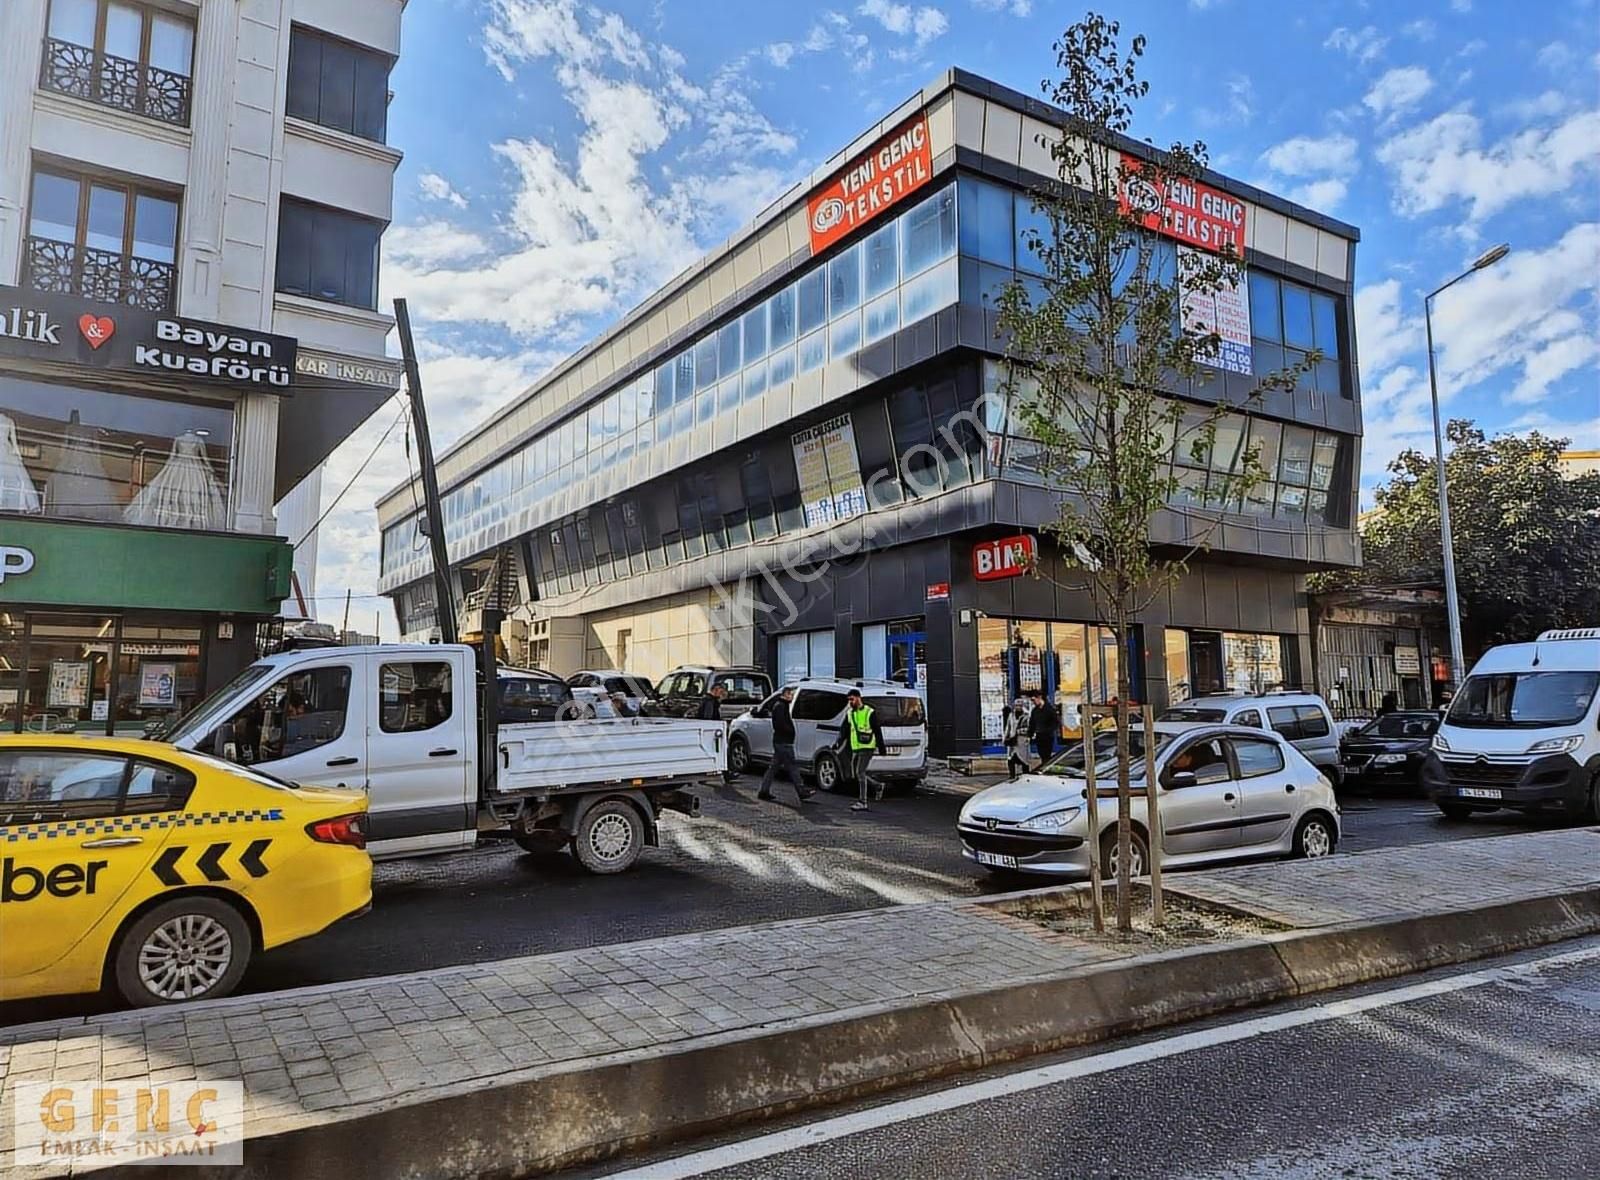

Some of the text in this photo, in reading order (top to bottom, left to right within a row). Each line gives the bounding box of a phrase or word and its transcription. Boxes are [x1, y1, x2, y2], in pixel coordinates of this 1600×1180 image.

[878, 122, 925, 172] GENÇ
[1201, 192, 1242, 229] GENÇ
[156, 320, 272, 358] Bayan
[135, 345, 290, 386] Kuaförü
